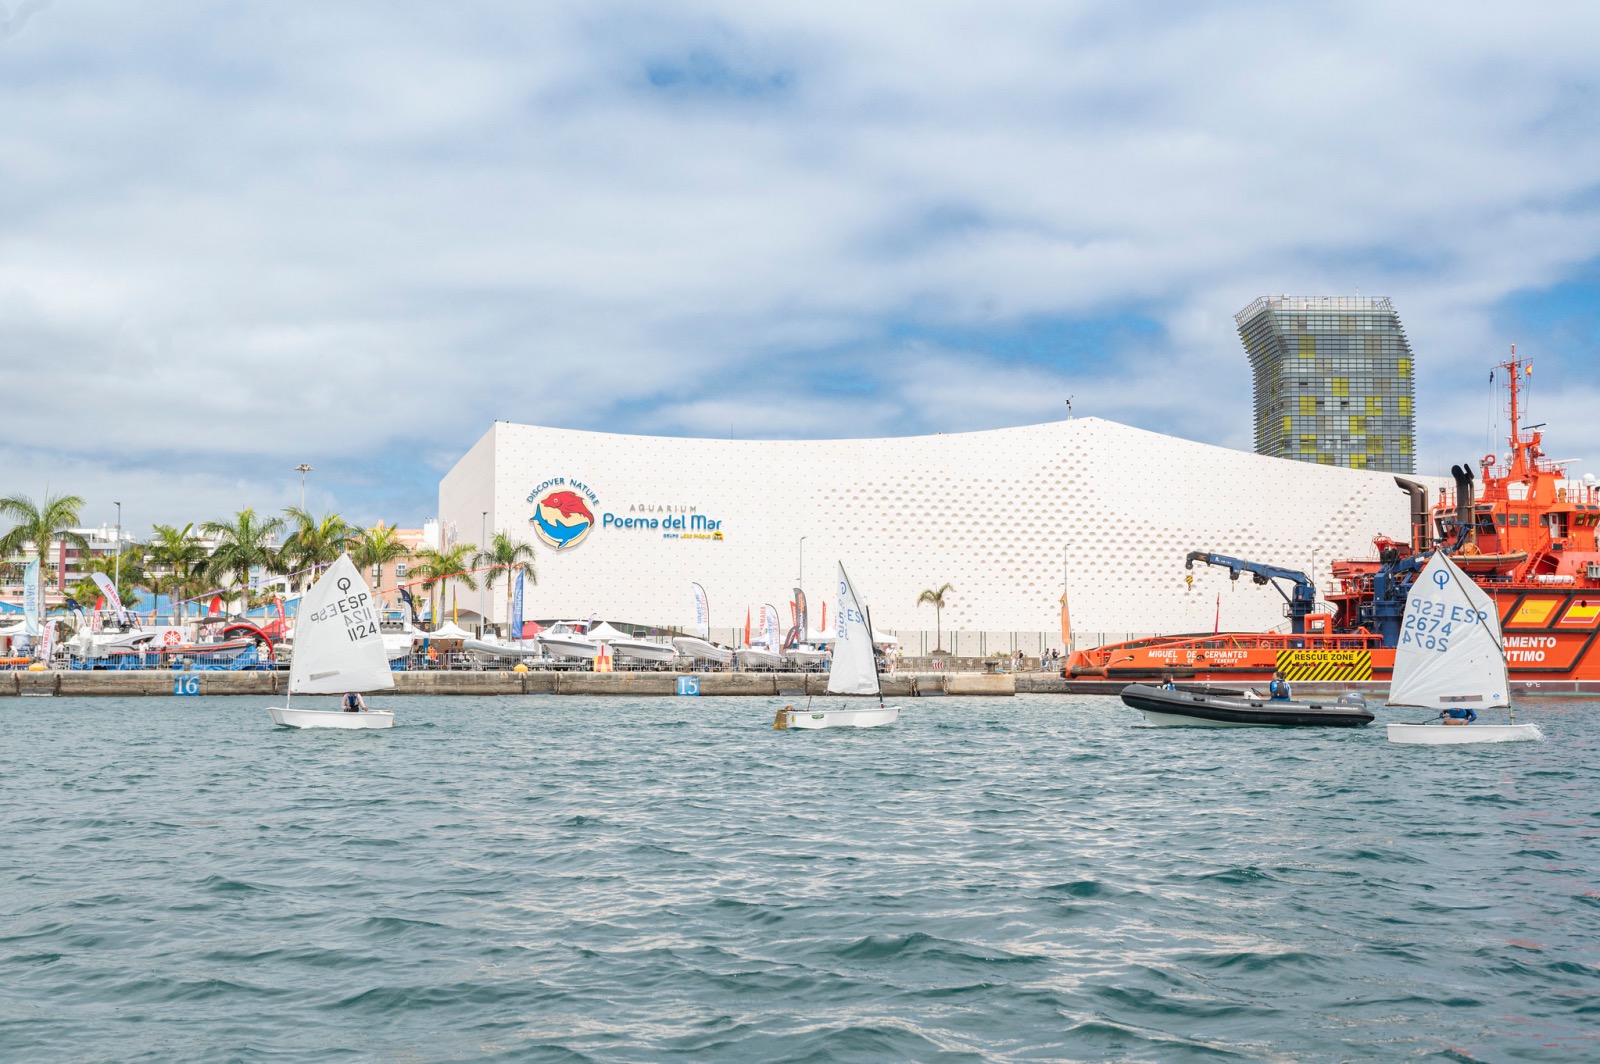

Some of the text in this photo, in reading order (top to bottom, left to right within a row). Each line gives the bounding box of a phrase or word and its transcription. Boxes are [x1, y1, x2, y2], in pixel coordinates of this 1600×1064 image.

[526, 477, 600, 507] DISCOVER NATURE
[629, 503, 697, 513] AQUARIUM
[602, 512, 722, 530] Poema del Mar
[338, 593, 367, 613] ESP
[847, 608, 865, 623] ES
[1450, 605, 1488, 625] ESP
[347, 621, 377, 641] 1124
[1405, 614, 1452, 636] 2674
[1148, 650, 1178, 658] MIGUEL
[1204, 651, 1248, 659] CERVANTES
[1294, 653, 1354, 661] RESCUE ZONE
[175, 676, 198, 695] 16
[679, 678, 698, 695] 15
